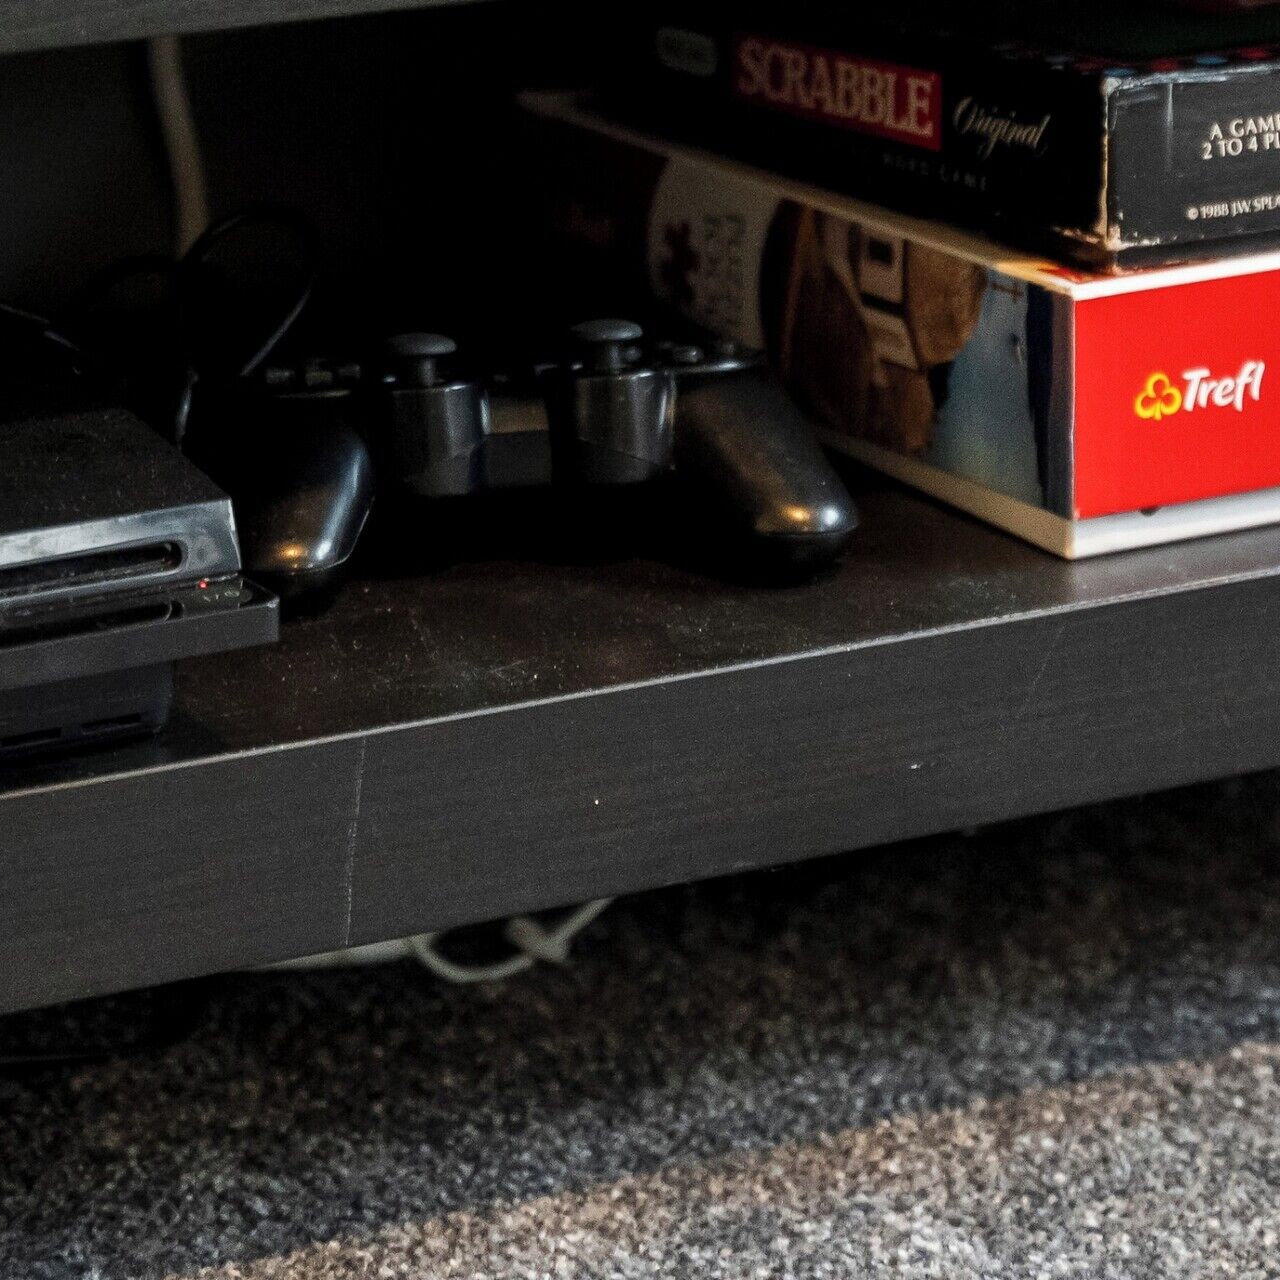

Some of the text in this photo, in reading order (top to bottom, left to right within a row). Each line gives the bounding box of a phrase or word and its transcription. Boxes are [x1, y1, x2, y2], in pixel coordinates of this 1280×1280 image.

[737, 37, 933, 138] SCRABBLE
[953, 96, 1051, 160] Original
[1201, 141, 1213, 160] 2
[1217, 138, 1243, 157] TO
[1247, 135, 1258, 153] 4
[1209, 122, 1223, 141] A
[1182, 359, 1266, 412] Trefl
